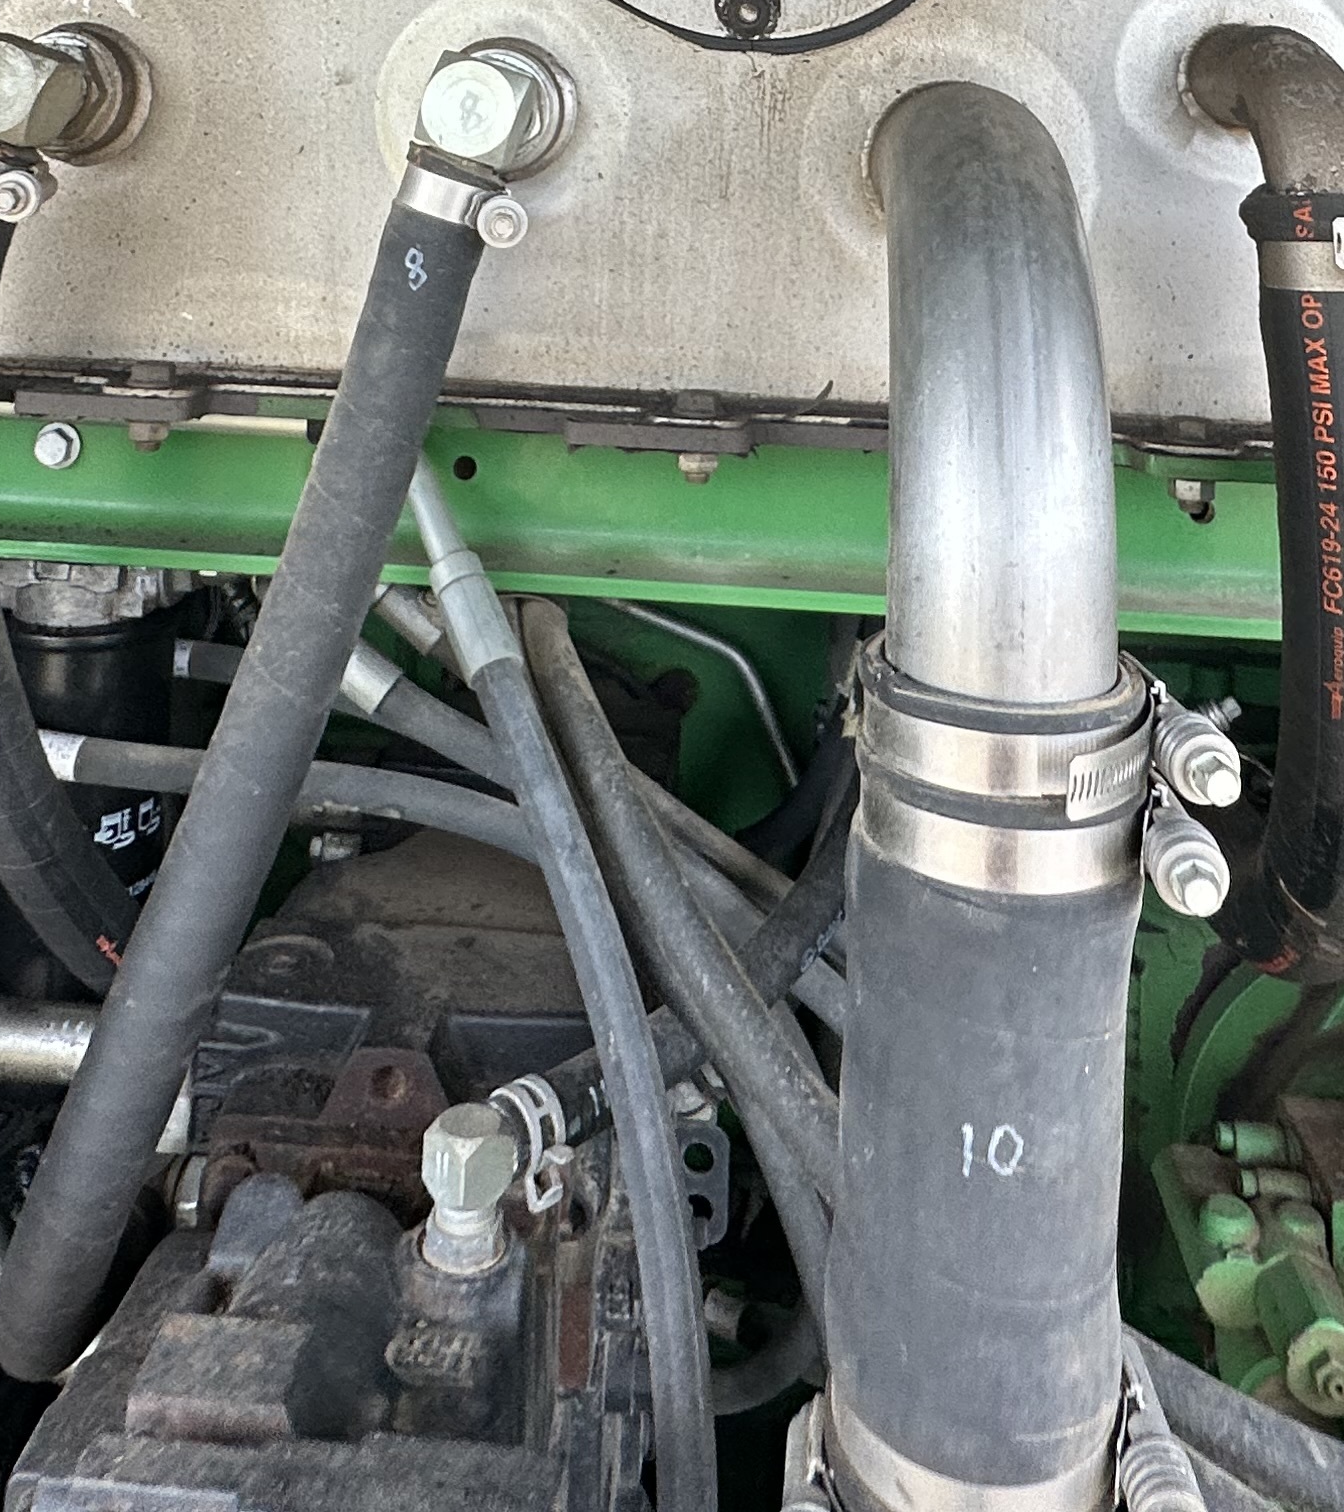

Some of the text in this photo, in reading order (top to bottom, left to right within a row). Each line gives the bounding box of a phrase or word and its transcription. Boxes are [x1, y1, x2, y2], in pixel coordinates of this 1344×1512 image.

[405, 246, 428, 292] 8
[1301, 292, 1325, 330] OP
[1304, 336, 1331, 396] MAX
[1312, 400, 1336, 444] PSI
[1316, 449, 1338, 492] 150
[1318, 500, 1344, 616] FC619-24
[1324, 625, 1344, 701] Aeroquip
[961, 1122, 1024, 1178] 10
